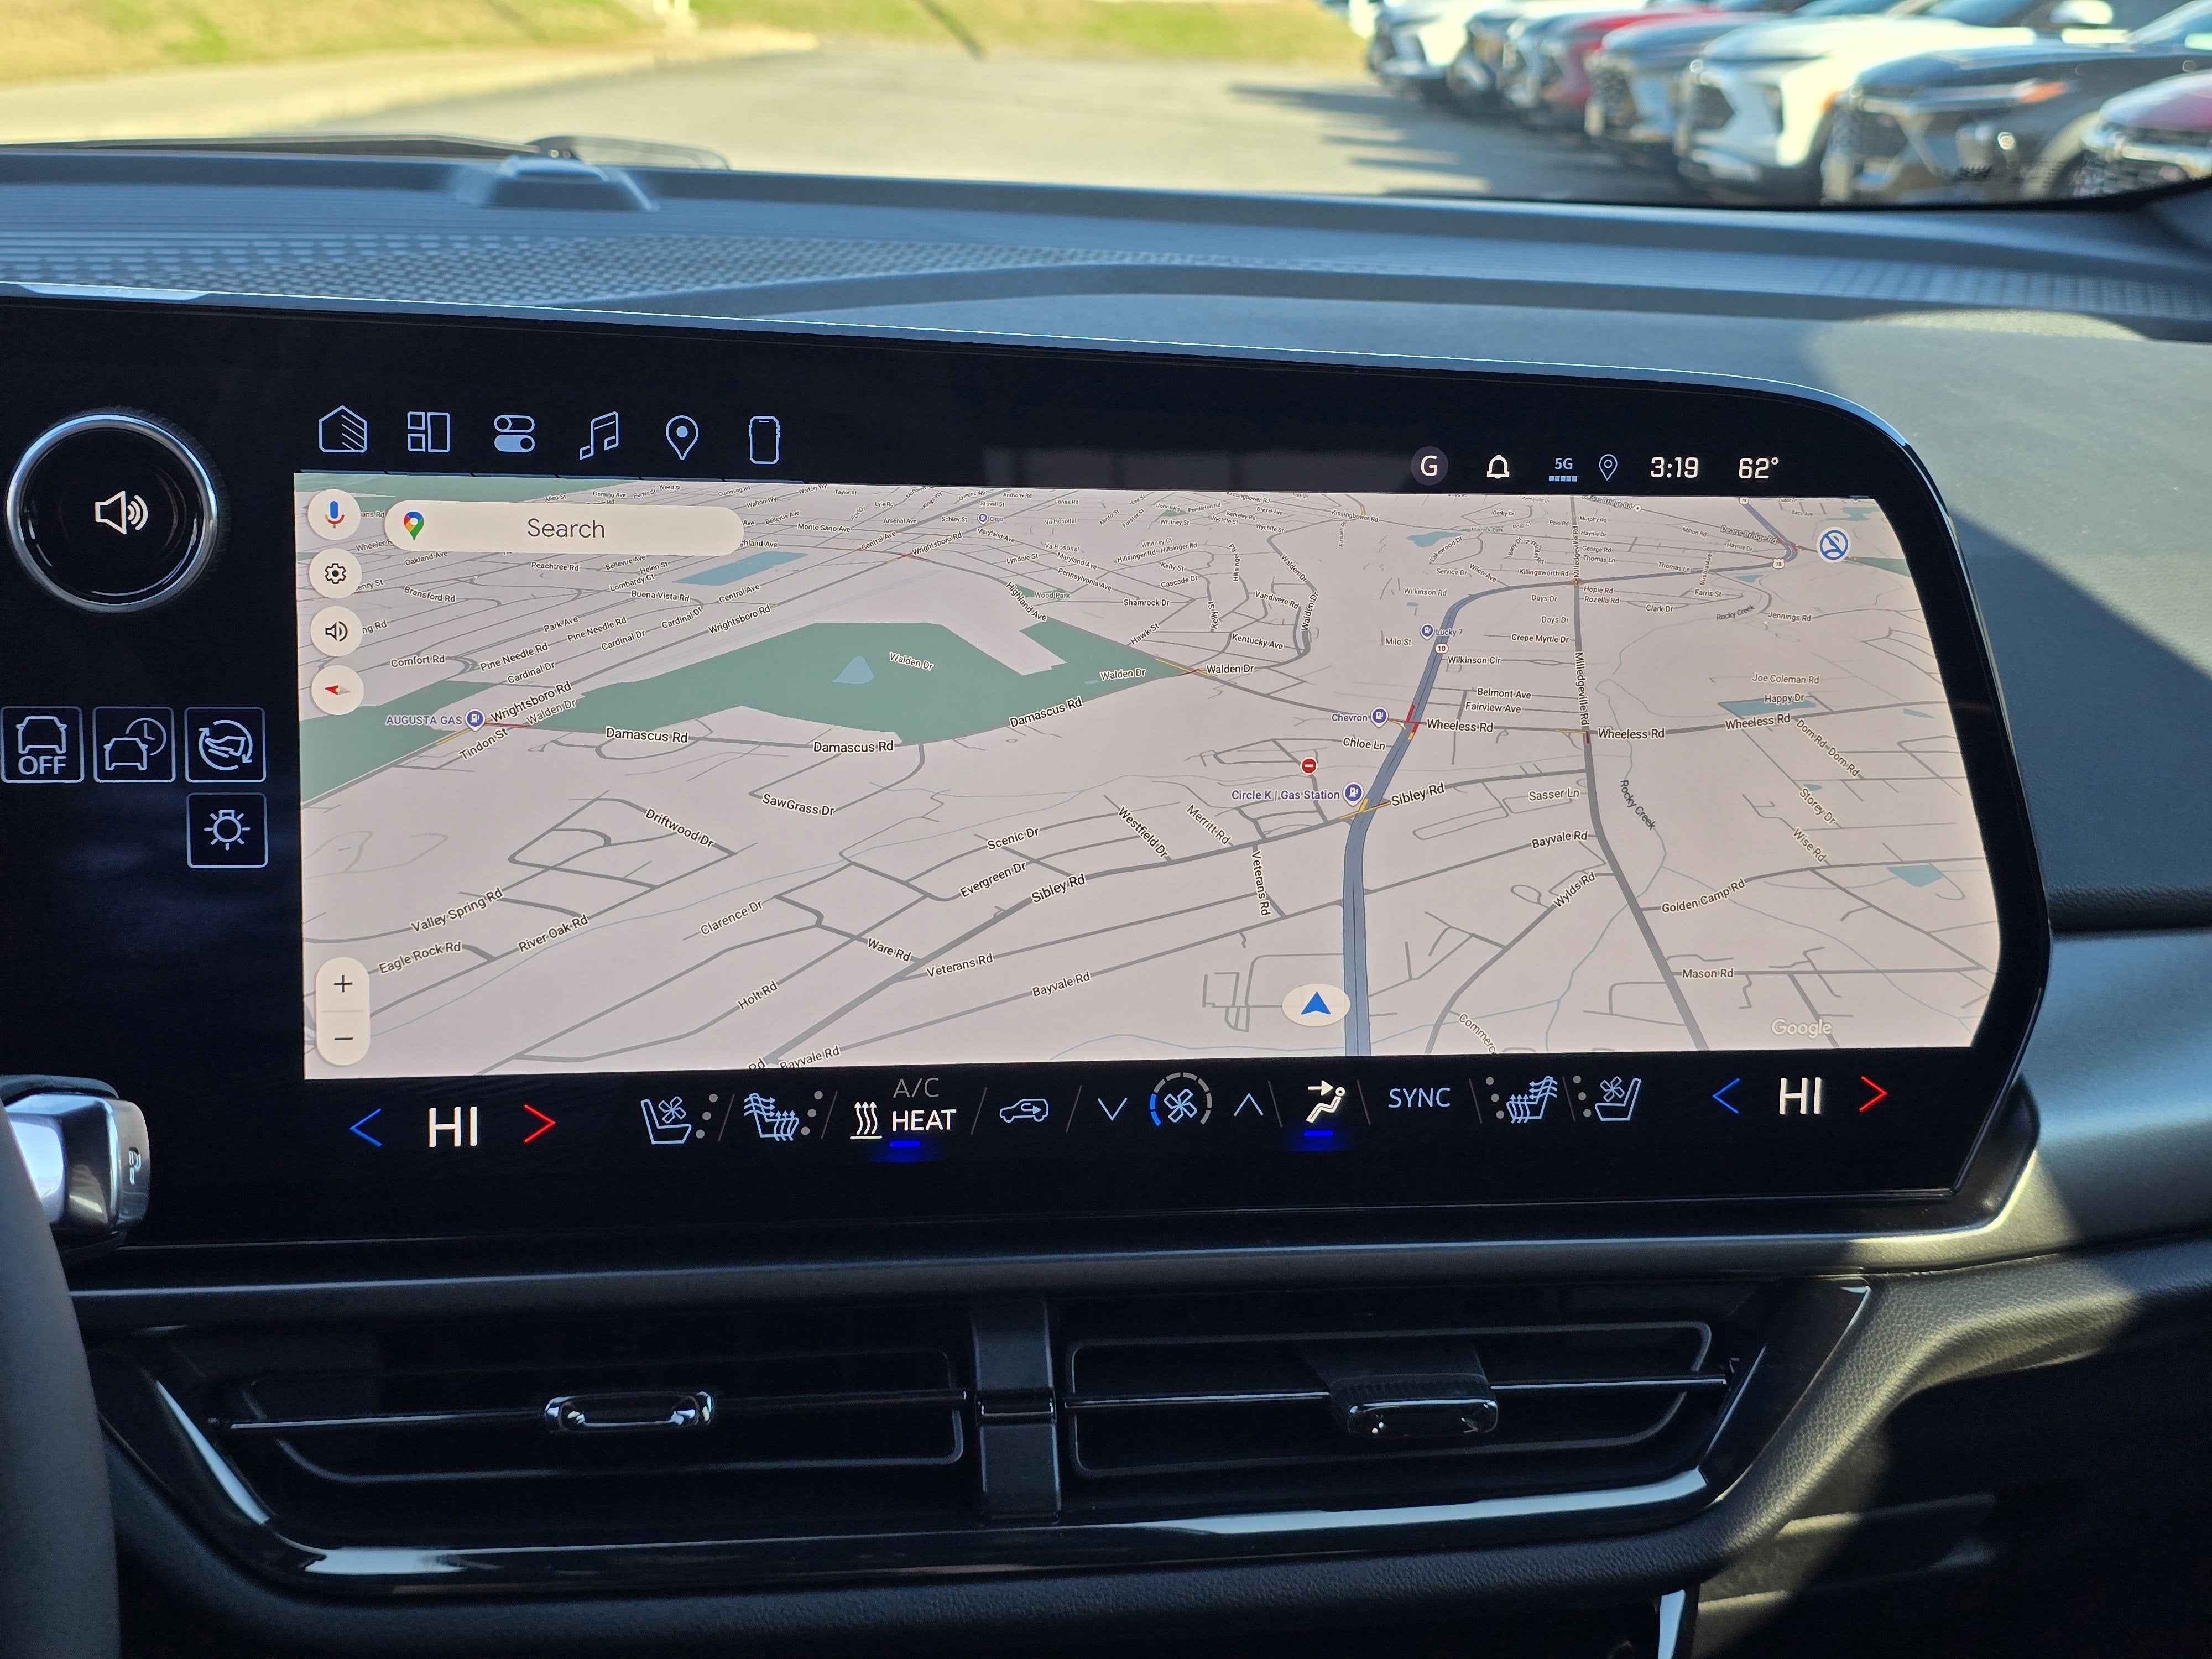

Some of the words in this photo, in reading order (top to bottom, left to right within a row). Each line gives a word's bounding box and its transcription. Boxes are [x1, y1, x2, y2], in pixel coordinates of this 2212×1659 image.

[1421, 456, 1438, 476] G
[1555, 458, 1573, 469] 5G
[1651, 457, 1698, 478] 3:19
[1739, 457, 1778, 479] 62°
[528, 518, 605, 538] Search
[1720, 525, 1742, 537] Deans
[1743, 530, 1767, 543] Bridge
[1767, 536, 1777, 545] Rd
[405, 555, 434, 566] Oakland
[531, 562, 568, 571] Peachtree
[610, 576, 645, 592] Lombardy
[1058, 567, 1099, 588] Pennsylvania
[1099, 582, 1112, 591] Ave
[404, 586, 444, 602] Bransford
[445, 594, 456, 602] Rd
[631, 591, 655, 599] Buena
[658, 592, 677, 600] Vista
[719, 589, 745, 603] Central
[745, 583, 760, 593] Ave
[708, 611, 755, 634] Wrightsboro
[757, 604, 771, 618] Rd
[1768, 612, 1801, 622] Jennings
[1130, 629, 1152, 645] Hawk
[1150, 623, 1160, 632] St
[1232, 633, 1267, 648] Kentucky
[1269, 639, 1284, 650] Ave
[1511, 634, 1533, 644] Crepe
[1535, 635, 1558, 644] Myrtle
[392, 656, 430, 667] Comfort
[433, 655, 445, 664] Rd
[480, 659, 500, 671] Pine
[502, 647, 533, 665] Needle
[535, 643, 549, 653] Rd
[890, 653, 921, 668] Walden
[923, 661, 933, 670] Dr
[508, 668, 542, 684] Cardinal
[544, 663, 555, 672] Dr
[1206, 665, 1241, 674] Walden
[1244, 665, 1254, 673] Dr
[1770, 675, 1806, 684] Coleman
[1575, 652, 1588, 711] Milledgeville
[492, 692, 555, 722] Wrightsboro
[555, 681, 572, 695] Rd
[1477, 688, 1514, 697] Belmont
[1516, 691, 1531, 699] Ave
[1765, 694, 1792, 704] Happy
[1010, 704, 1066, 728] Damascus
[1067, 697, 1082, 710] Rd
[1466, 702, 1502, 712] Fairview
[1504, 705, 1521, 713] Ave
[387, 716, 436, 724] AUGUSTA
[440, 716, 462, 724] GAS
[1427, 719, 1477, 732] Wheeless
[1479, 722, 1493, 732] Rd
[1581, 713, 1589, 726] Rd
[459, 735, 494, 761] Tindon
[495, 729, 508, 740] St
[606, 727, 668, 742] Damascus
[672, 732, 688, 743] Rd
[1343, 738, 1371, 748] Chloe
[1374, 742, 1385, 750] Ln
[18, 755, 67, 775] OFF
[762, 793, 818, 815] SawGrass
[821, 806, 834, 816] Dr
[1232, 790, 1262, 800] Circle
[1265, 791, 1271, 800] K
[1281, 791, 1301, 800] Gas
[1304, 790, 1339, 799] Station
[1529, 790, 1564, 801] Sasser
[1567, 789, 1579, 797] Ln
[1620, 780, 1636, 807] Rocky
[1634, 805, 1655, 830] Creek
[1800, 789, 1825, 816] Storey
[1823, 812, 1836, 824] Dr
[645, 808, 700, 842] Driftwood
[698, 833, 714, 848] Dr
[1119, 807, 1157, 848] Westfield
[1154, 842, 1168, 858] Dr
[1187, 805, 1218, 835] Merritt
[1216, 830, 1230, 845] Rd
[988, 834, 1024, 850] Scenic
[1026, 827, 1039, 838] Dr
[1793, 828, 1815, 852] Wise
[1813, 847, 1827, 862] Rd
[961, 868, 1011, 898] Evergreen
[1013, 861, 1026, 873] Dr
[1031, 879, 1066, 904] Sibley
[1067, 874, 1085, 887] Rd
[1553, 881, 1581, 907] Wylds
[1581, 872, 1595, 885] Rd
[1662, 900, 1698, 912] Golden
[1701, 888, 1730, 906] Camp
[1731, 879, 1745, 891] Rd
[411, 915, 446, 932] Valley
[447, 896, 487, 919] Spring
[486, 888, 502, 902] Rd
[700, 907, 747, 935] Clarence
[748, 900, 763, 912] Dr
[518, 935, 547, 952] River
[549, 924, 571, 939] Oak
[572, 915, 588, 928] Rd
[379, 954, 411, 973] Eagle
[413, 945, 444, 961] Rock
[445, 941, 461, 953] Rd
[867, 939, 893, 957] Ware
[894, 948, 910, 962] Rd
[927, 959, 975, 977] Veterans
[978, 953, 993, 965] Rd
[1683, 969, 1717, 979] Mason
[1721, 968, 1734, 978] Rd
[738, 990, 760, 1009] Holt
[760, 980, 778, 997] Rd
[1032, 978, 1073, 997] Bayvale
[1075, 971, 1090, 984] Rd
[1771, 1019, 1832, 1039] Google
[893, 1078, 940, 1098] A/C
[1388, 1088, 1451, 1108] SYNC
[1779, 1077, 1823, 1114] HI
[429, 1106, 477, 1147] HI
[893, 1109, 957, 1131] HEAT
